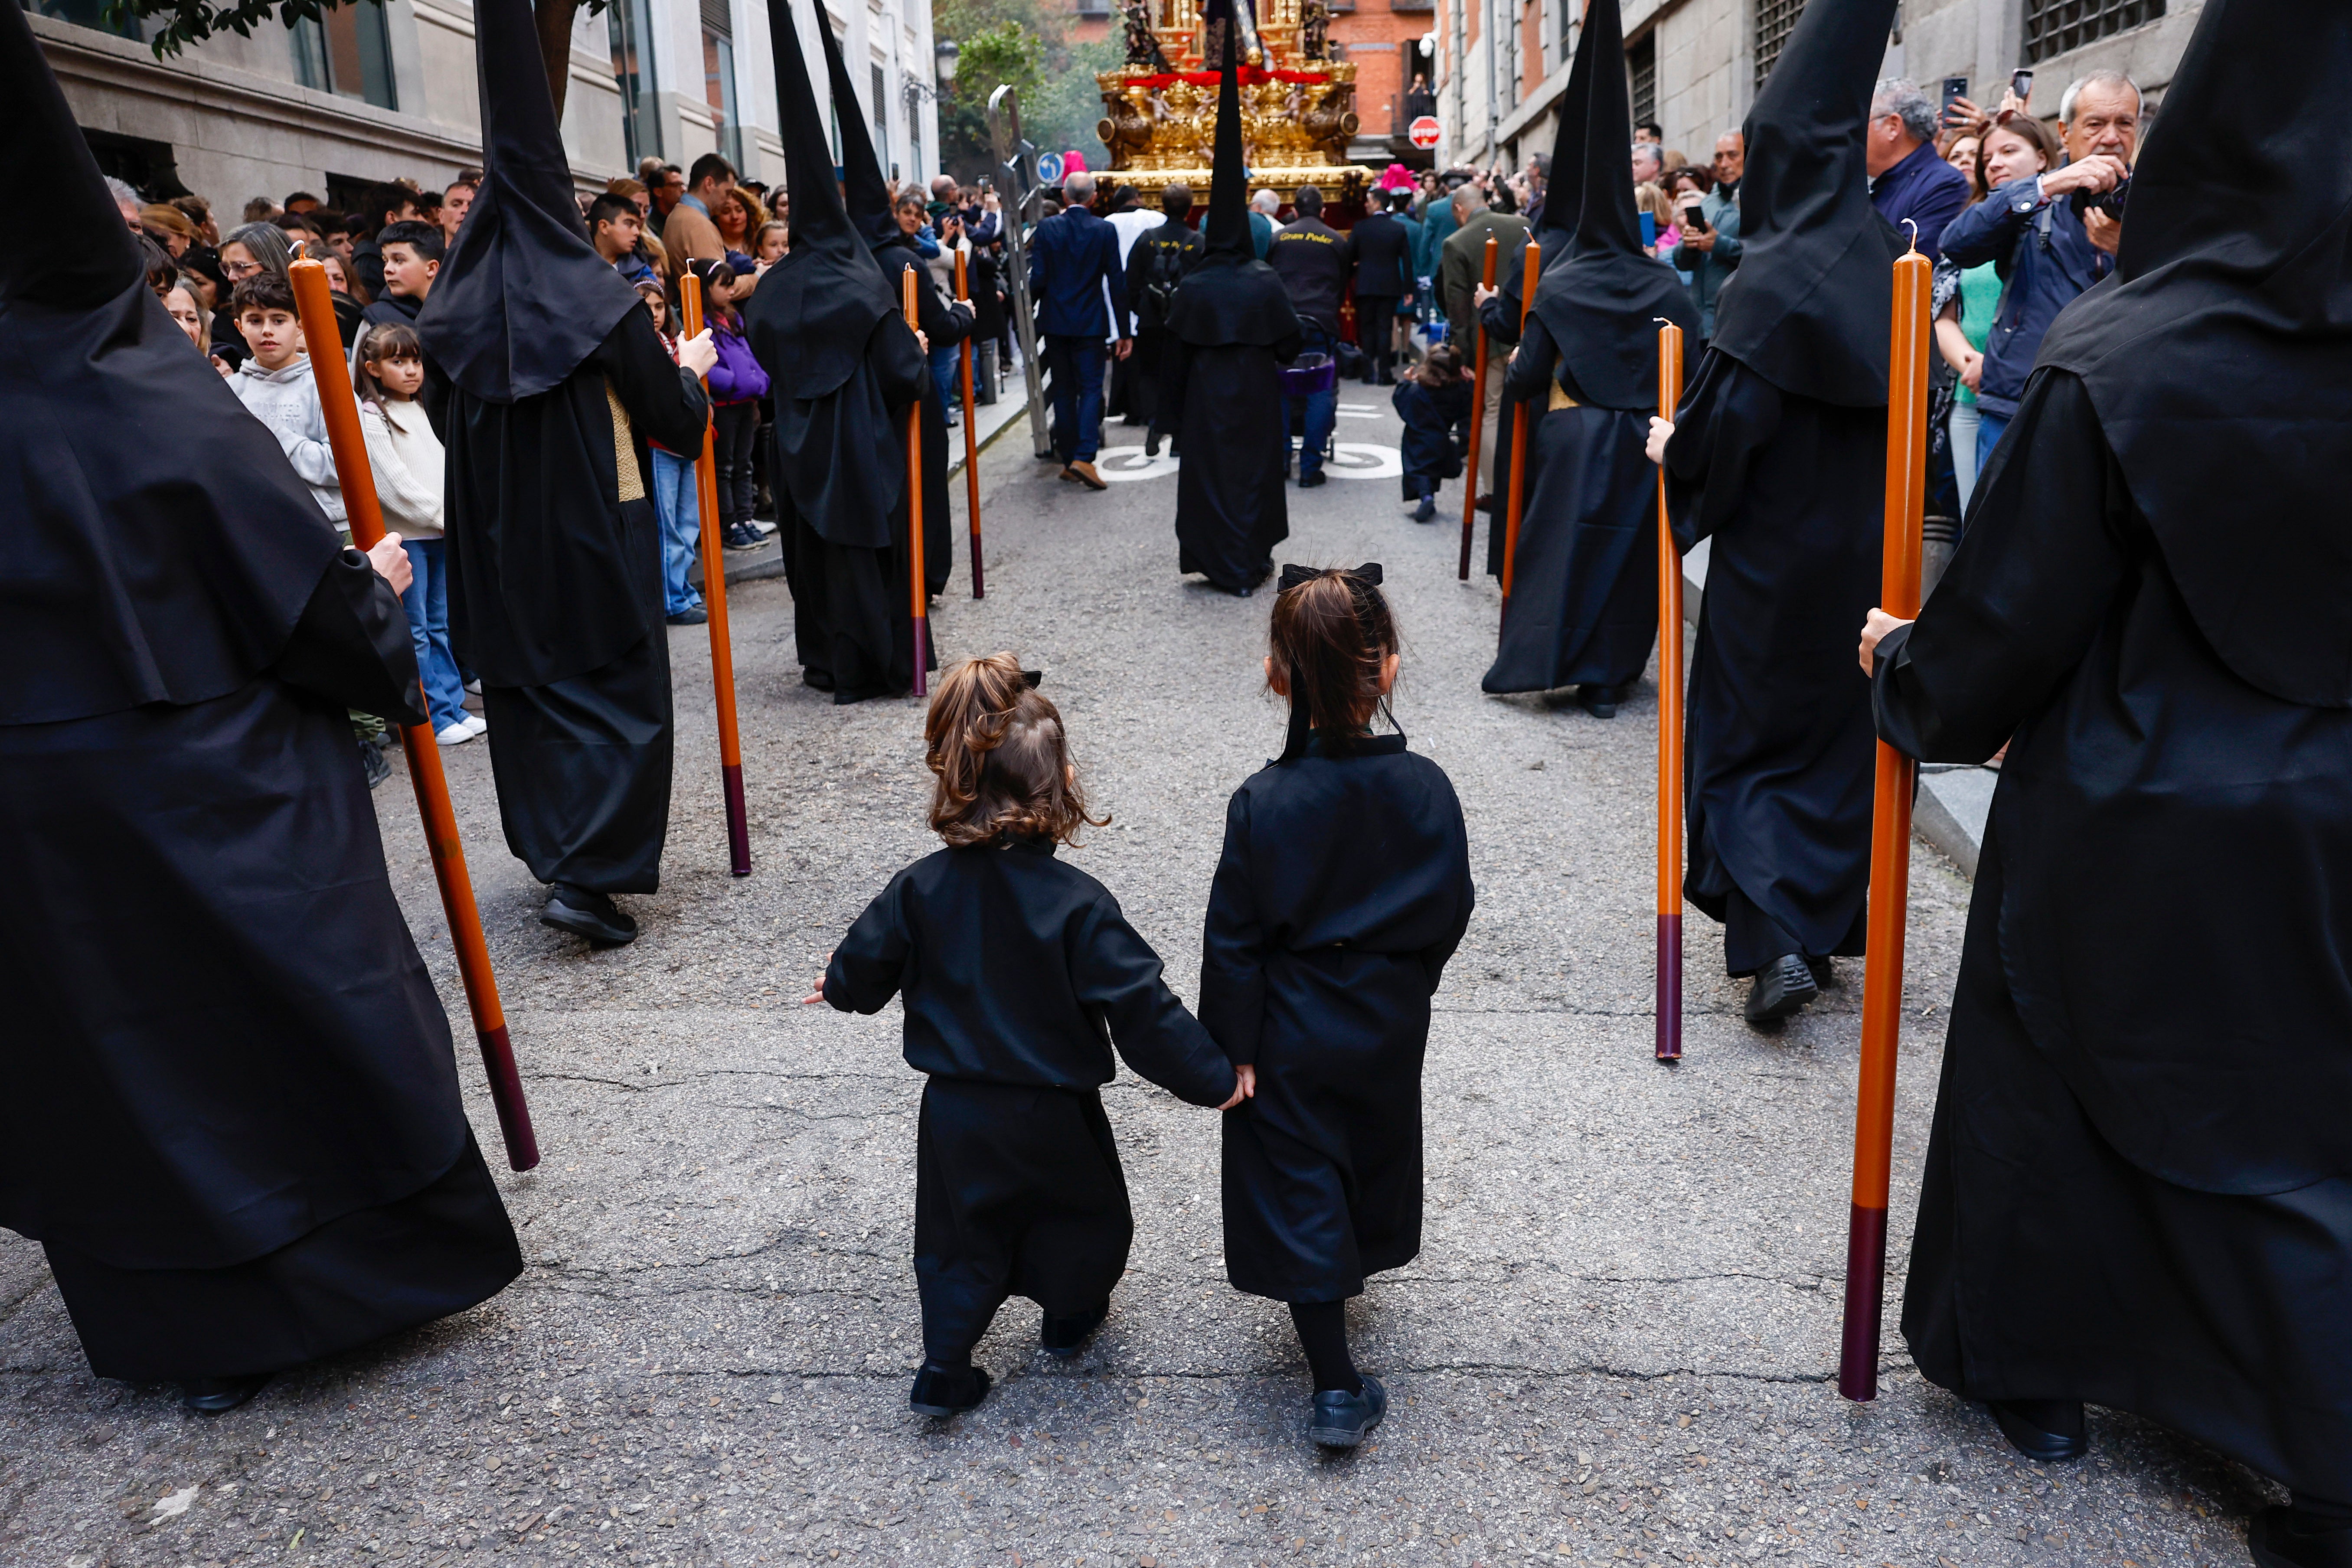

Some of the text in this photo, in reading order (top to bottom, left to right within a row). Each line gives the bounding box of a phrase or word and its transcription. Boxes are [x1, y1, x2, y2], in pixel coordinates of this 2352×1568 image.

[1413, 127, 1439, 138] STOP
[1280, 232, 1334, 244] Gran Poder
[1171, 240, 1194, 251] Poer
